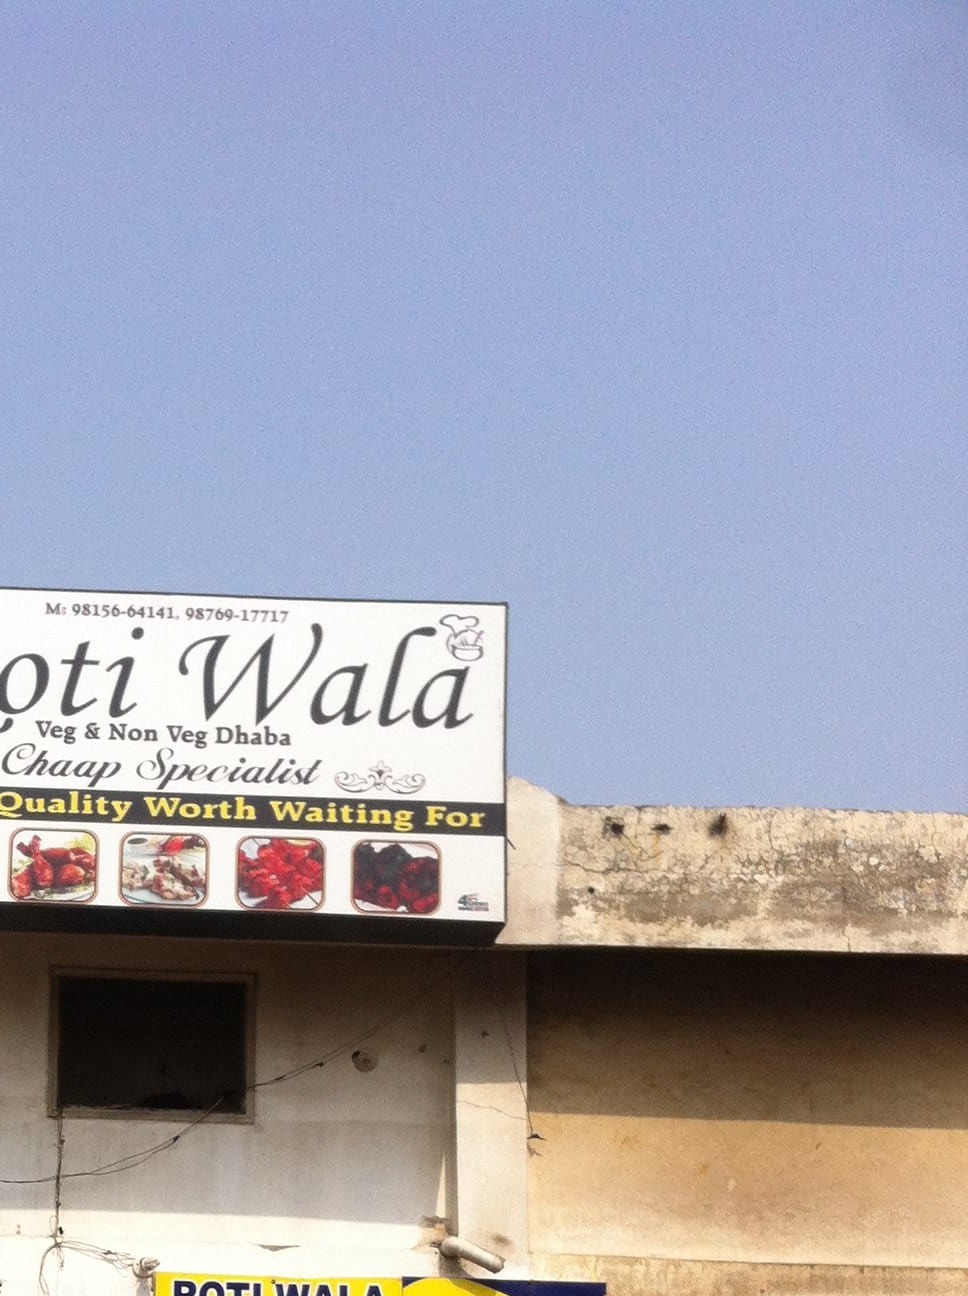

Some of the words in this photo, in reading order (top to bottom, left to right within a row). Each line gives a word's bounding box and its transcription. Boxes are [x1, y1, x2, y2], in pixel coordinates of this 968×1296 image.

[45, 602, 67, 616] M:
[72, 603, 179, 620] 98156-64141,
[185, 607, 289, 623] 98769-17717
[178, 622, 475, 730] Wala
[35, 720, 77, 744] Veg
[84, 722, 102, 740] &
[108, 723, 159, 742] Non
[166, 725, 208, 749] Veg
[215, 725, 292, 746] Dhaba
[1, 744, 122, 787] Chaap
[137, 748, 322, 790] Specialist
[146, 796, 257, 822] Worth
[269, 800, 414, 831] Waiting
[425, 805, 485, 829] For
